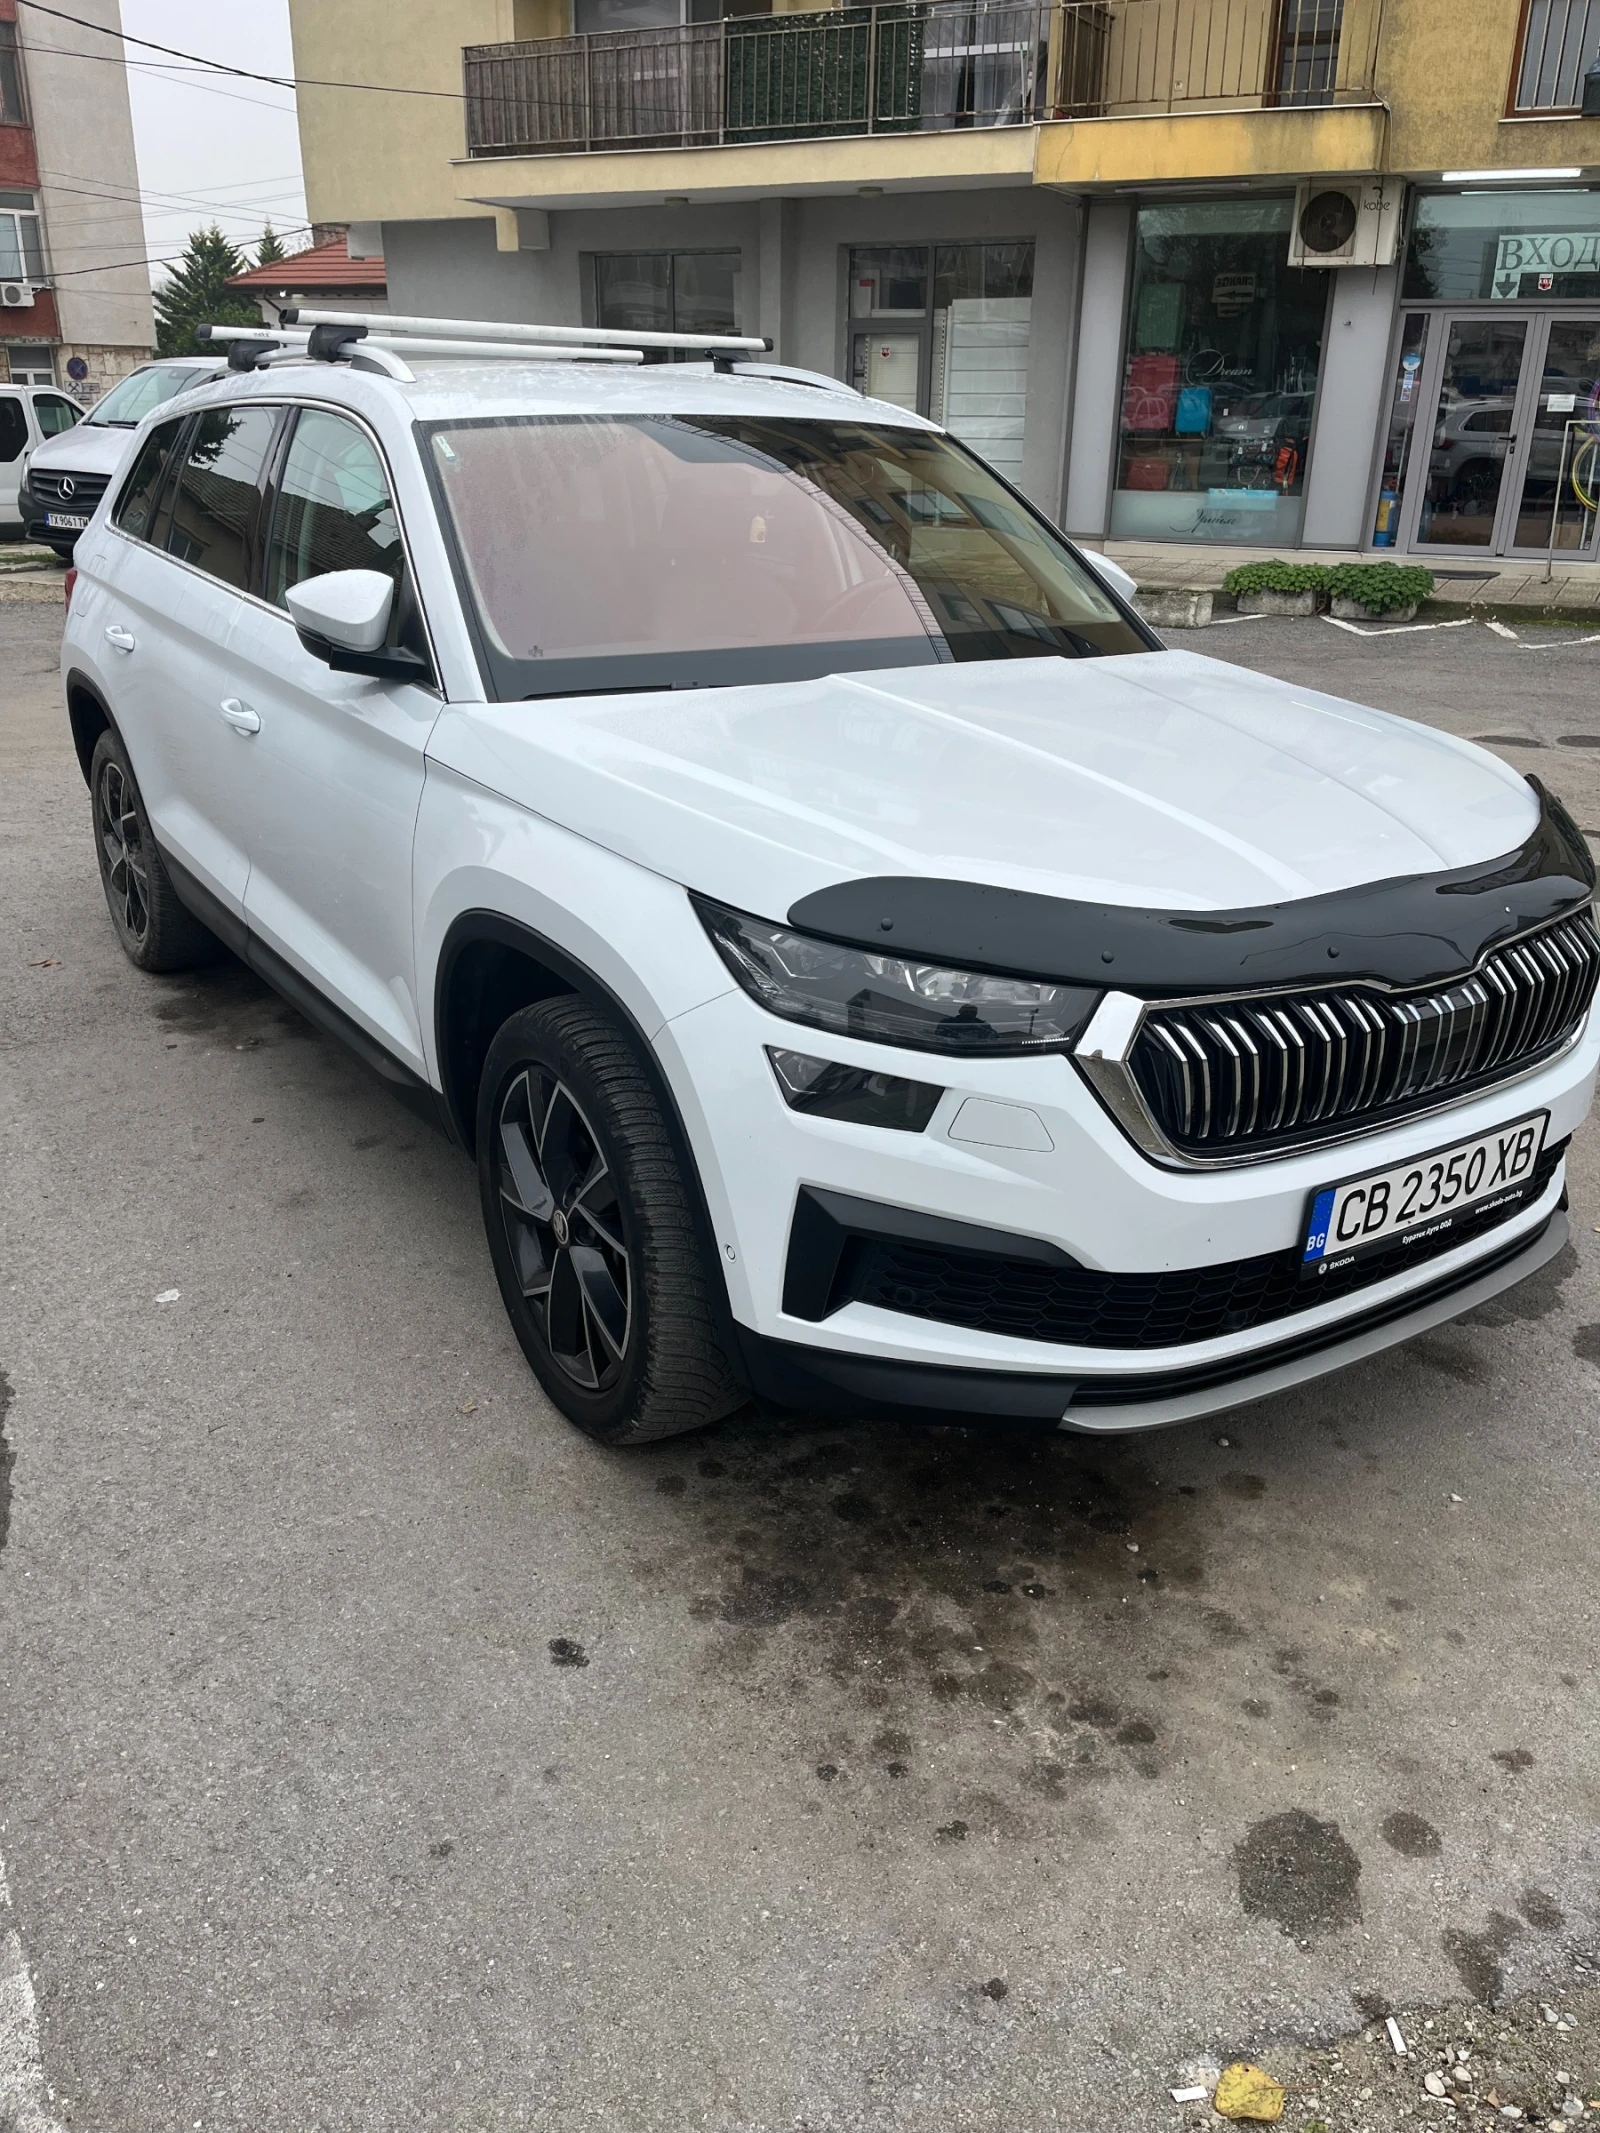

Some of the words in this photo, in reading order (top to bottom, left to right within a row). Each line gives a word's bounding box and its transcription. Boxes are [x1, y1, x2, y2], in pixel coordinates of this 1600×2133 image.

[1363, 199, 1390, 210] kobe
[1497, 236, 1600, 271] ВХОД
[1186, 349, 1253, 386] Dream
[1336, 1180, 1391, 1242] CB
[1395, 1146, 1487, 1223] 2350
[1488, 1127, 1535, 1188] XB
[1306, 1232, 1326, 1252] BG
